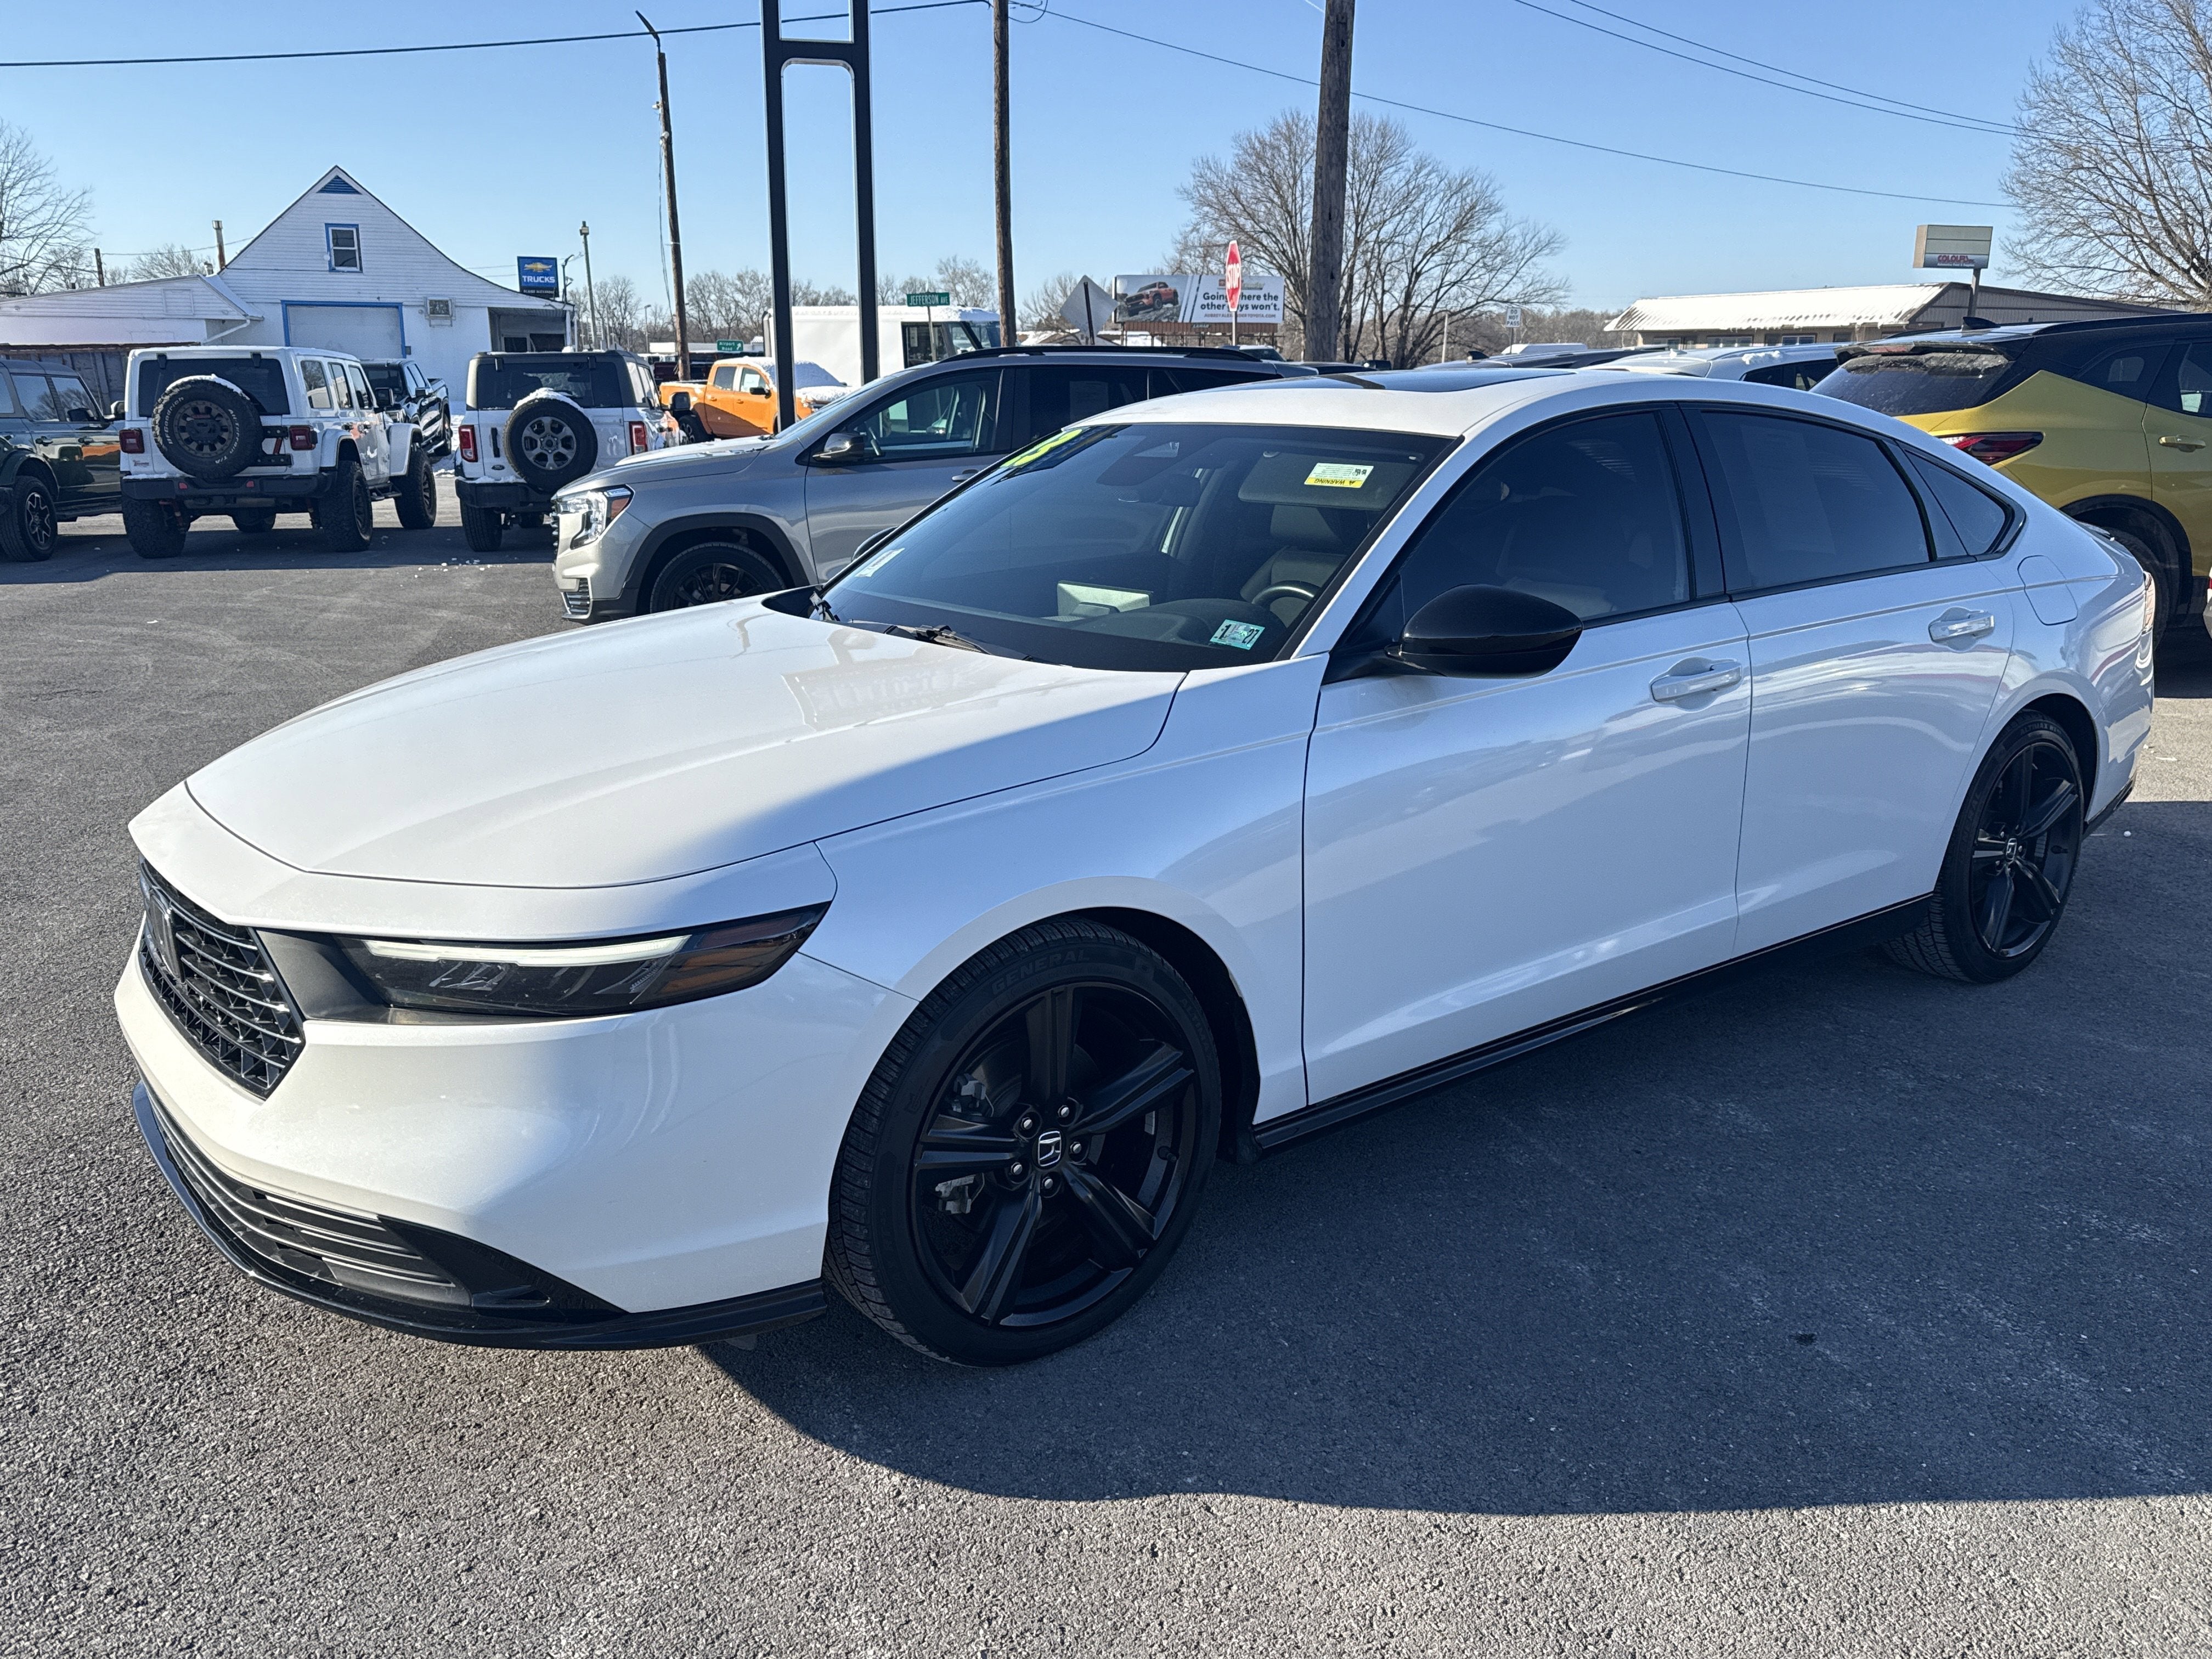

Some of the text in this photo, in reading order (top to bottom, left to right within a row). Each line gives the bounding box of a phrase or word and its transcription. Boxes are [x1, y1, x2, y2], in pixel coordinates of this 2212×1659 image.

[1227, 263, 1240, 289] STOP
[909, 294, 939, 306] JEFFERSON
[1239, 292, 1261, 301] here
[1263, 293, 1278, 301] the
[1200, 302, 1226, 310] other
[1251, 302, 1280, 311] won't.
[1242, 628, 1261, 645] 27
[991, 950, 1090, 995] GENERAL
